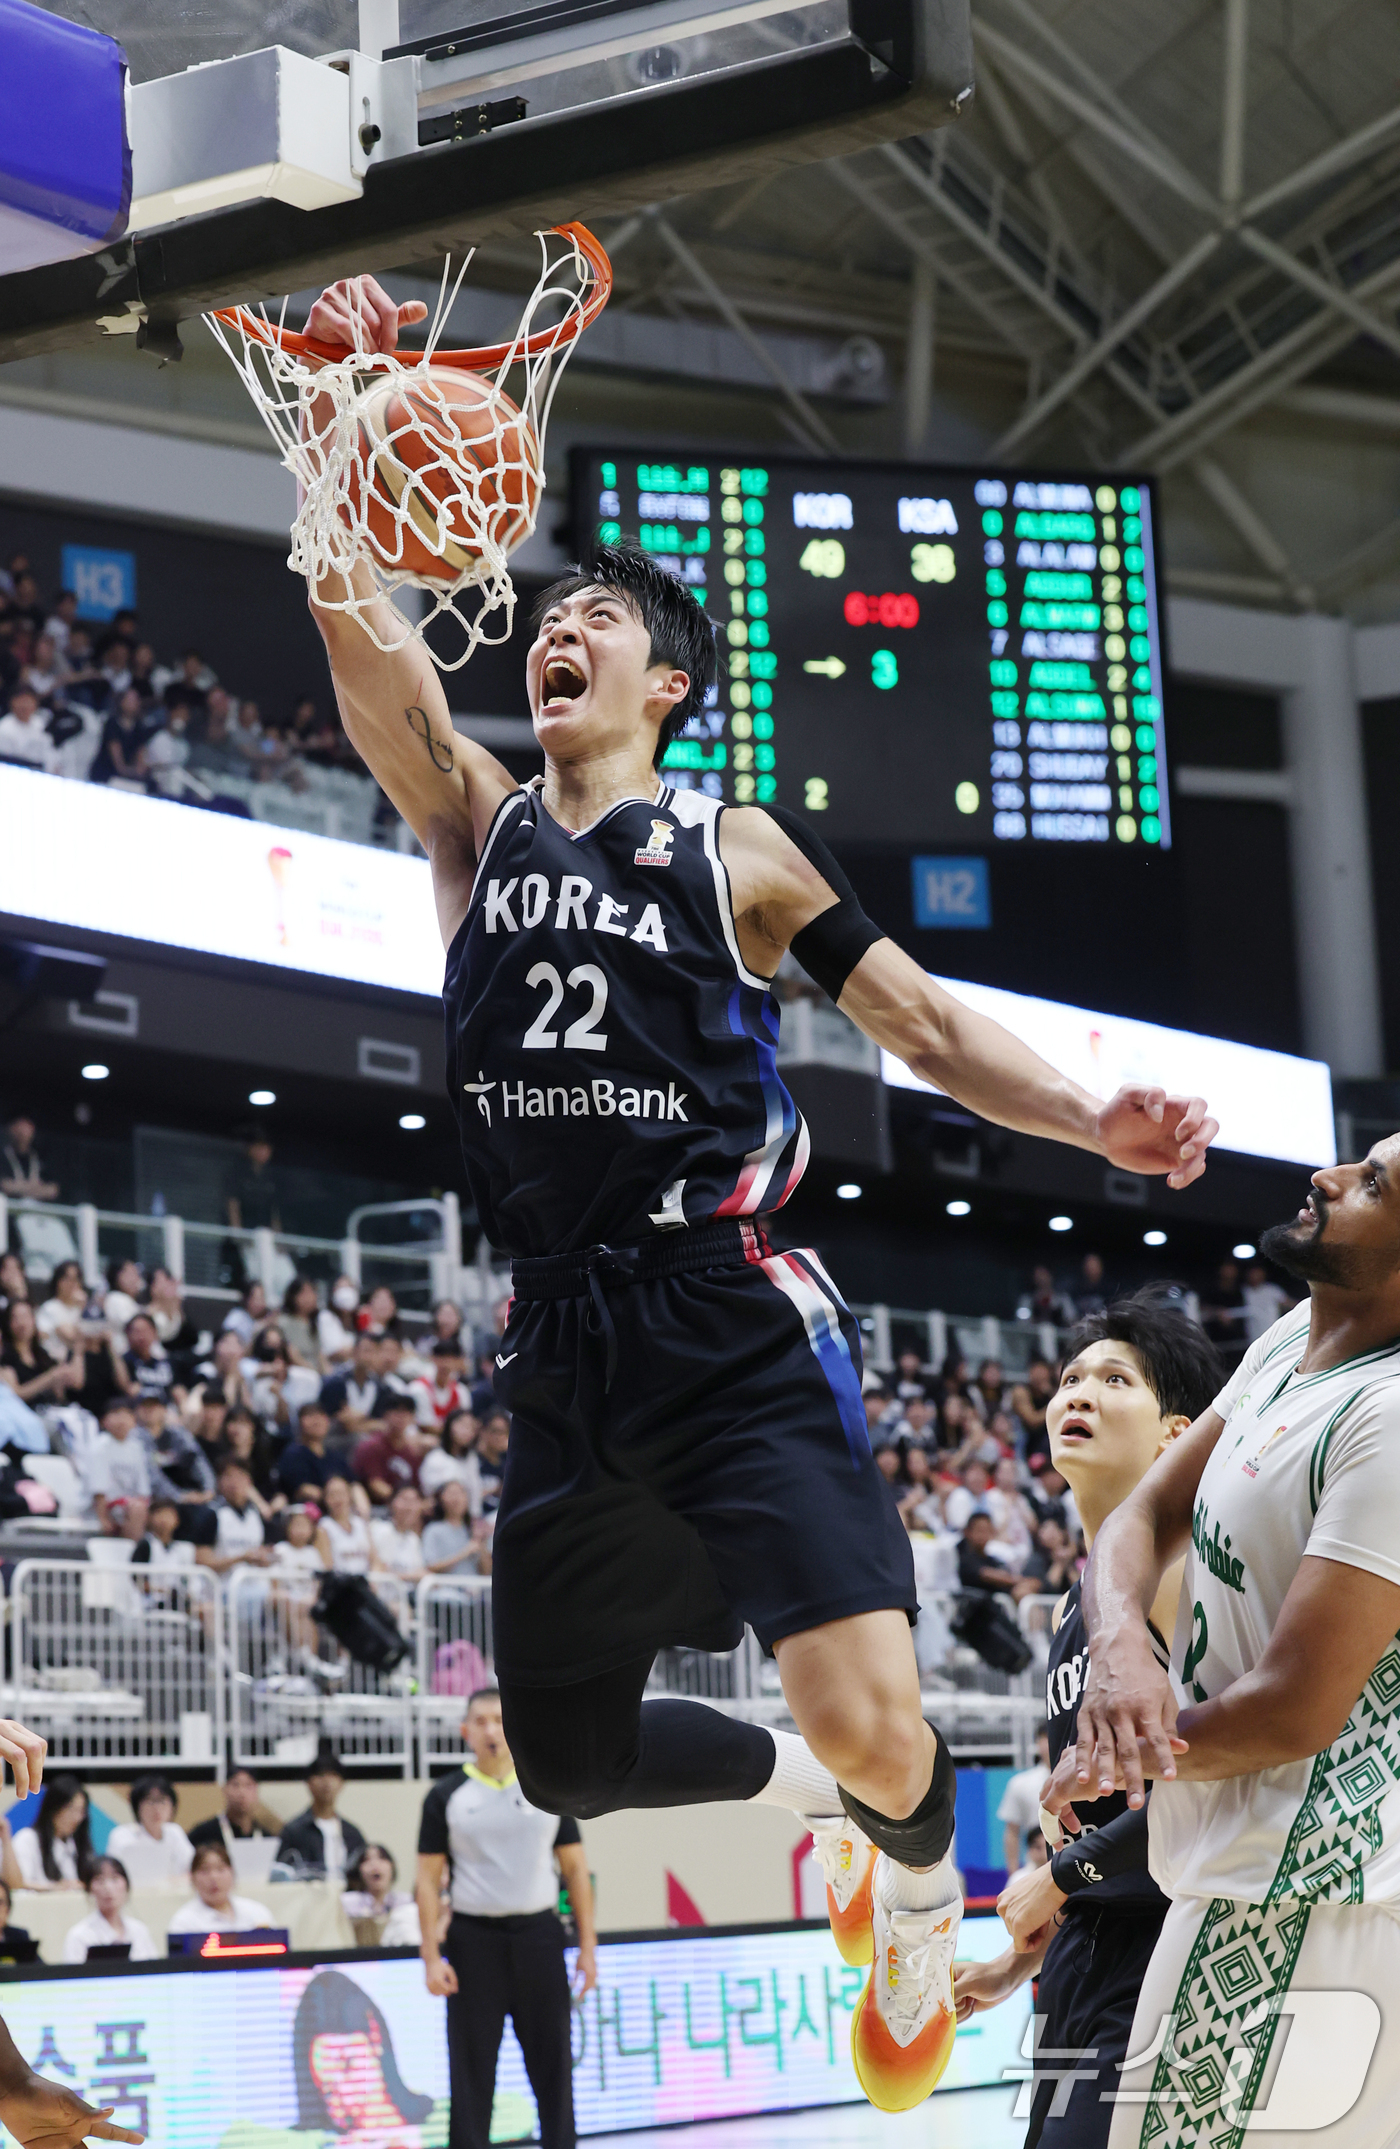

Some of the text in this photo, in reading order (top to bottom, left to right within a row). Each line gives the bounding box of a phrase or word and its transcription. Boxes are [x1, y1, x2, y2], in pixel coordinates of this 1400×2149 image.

[793, 492, 853, 530] KOR
[74, 561, 124, 608] H3
[871, 649, 899, 690] 3
[804, 777, 829, 811] 2
[635, 857, 669, 865] QUALIFIERS
[482, 873, 669, 953] KOREA
[926, 869, 977, 915] H2
[522, 961, 609, 1052] 22
[502, 1079, 689, 1122] HanaBank
